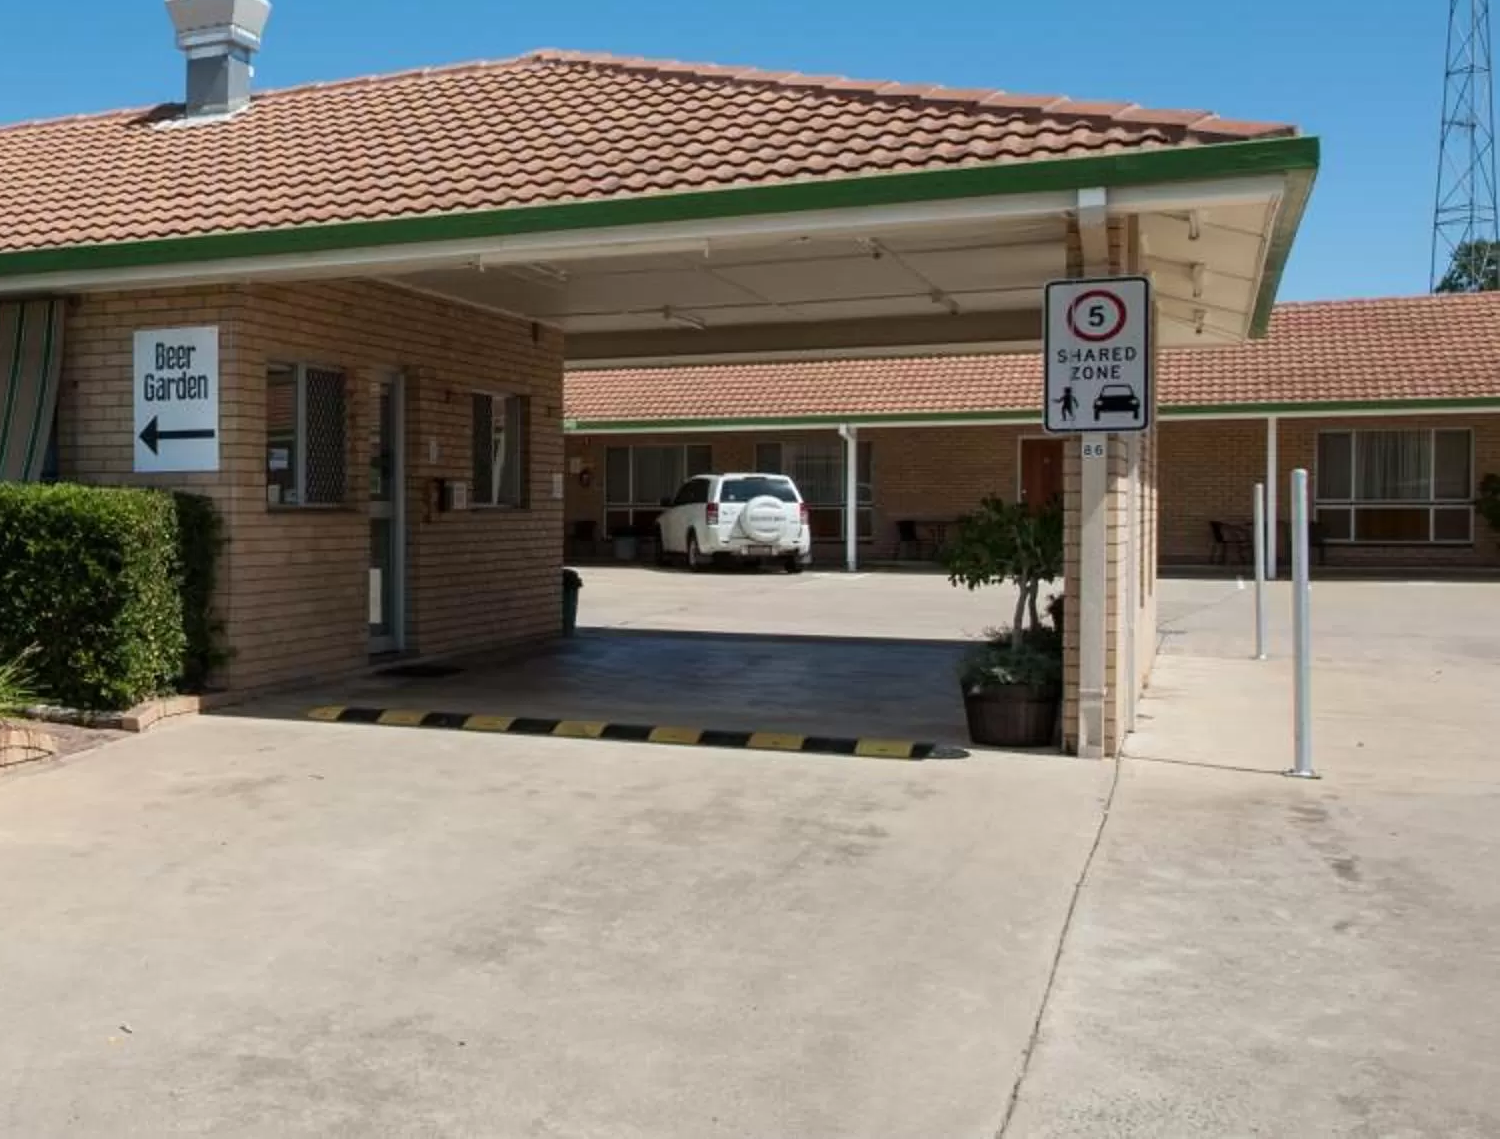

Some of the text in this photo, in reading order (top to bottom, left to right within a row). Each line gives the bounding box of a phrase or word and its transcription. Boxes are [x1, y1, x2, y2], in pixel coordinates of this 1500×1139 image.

[1088, 305, 1105, 327] 5
[155, 341, 196, 370] Beer
[1057, 346, 1137, 363] SHARED
[1071, 365, 1122, 381] ZONE
[143, 372, 209, 402] Garden
